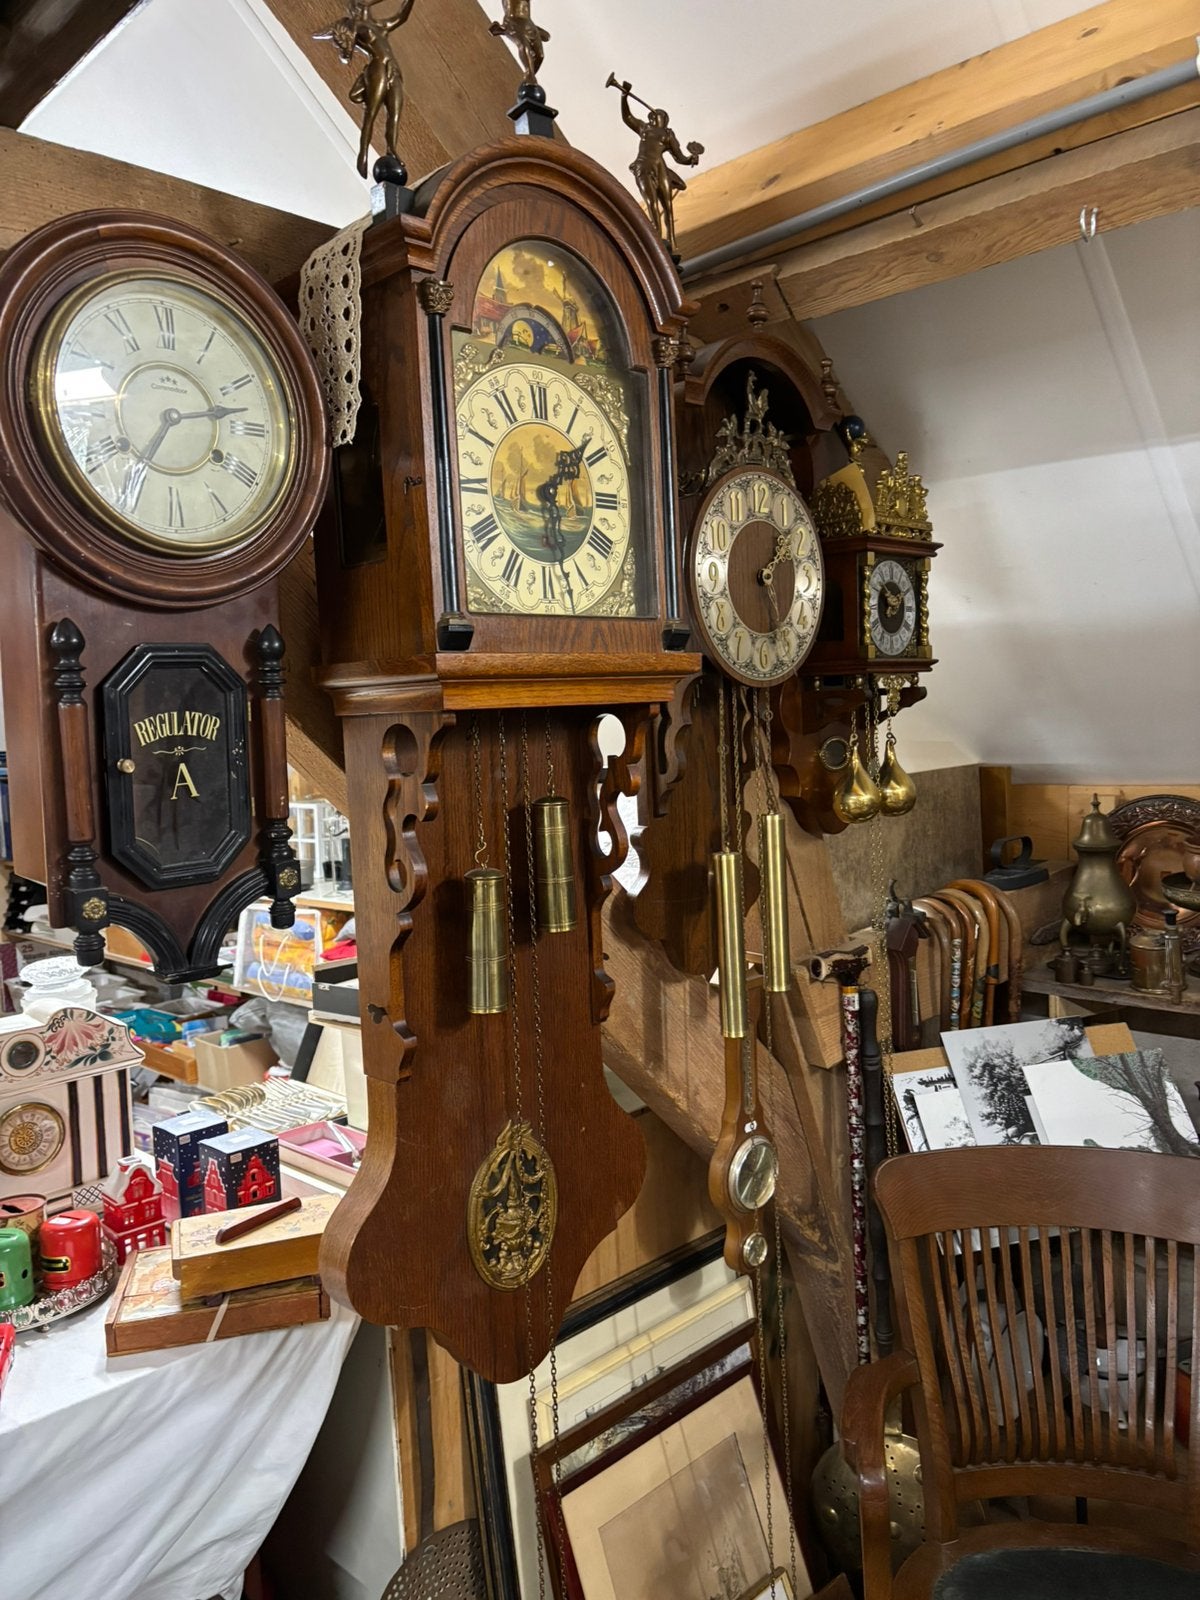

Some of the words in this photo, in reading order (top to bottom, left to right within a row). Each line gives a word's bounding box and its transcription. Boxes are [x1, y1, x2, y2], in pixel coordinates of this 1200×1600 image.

[219, 373, 254, 397] II
[532, 370, 544, 381] 60
[529, 384, 548, 421] XII
[229, 420, 265, 438] III
[584, 445, 608, 468] II
[594, 491, 618, 511] III
[729, 490, 743, 522] 11
[751, 482, 770, 514] 12
[780, 497, 788, 528] 1
[587, 525, 614, 560] IIII
[710, 519, 727, 553] 10
[796, 526, 806, 557] 2
[708, 561, 720, 593] 9
[803, 563, 813, 594] 3
[716, 601, 728, 636] 8
[796, 601, 809, 630] 4
[734, 630, 746, 662] 7
[759, 640, 770, 670] 6
[133, 710, 221, 747] REGULATOR
[170, 762, 200, 801] A
